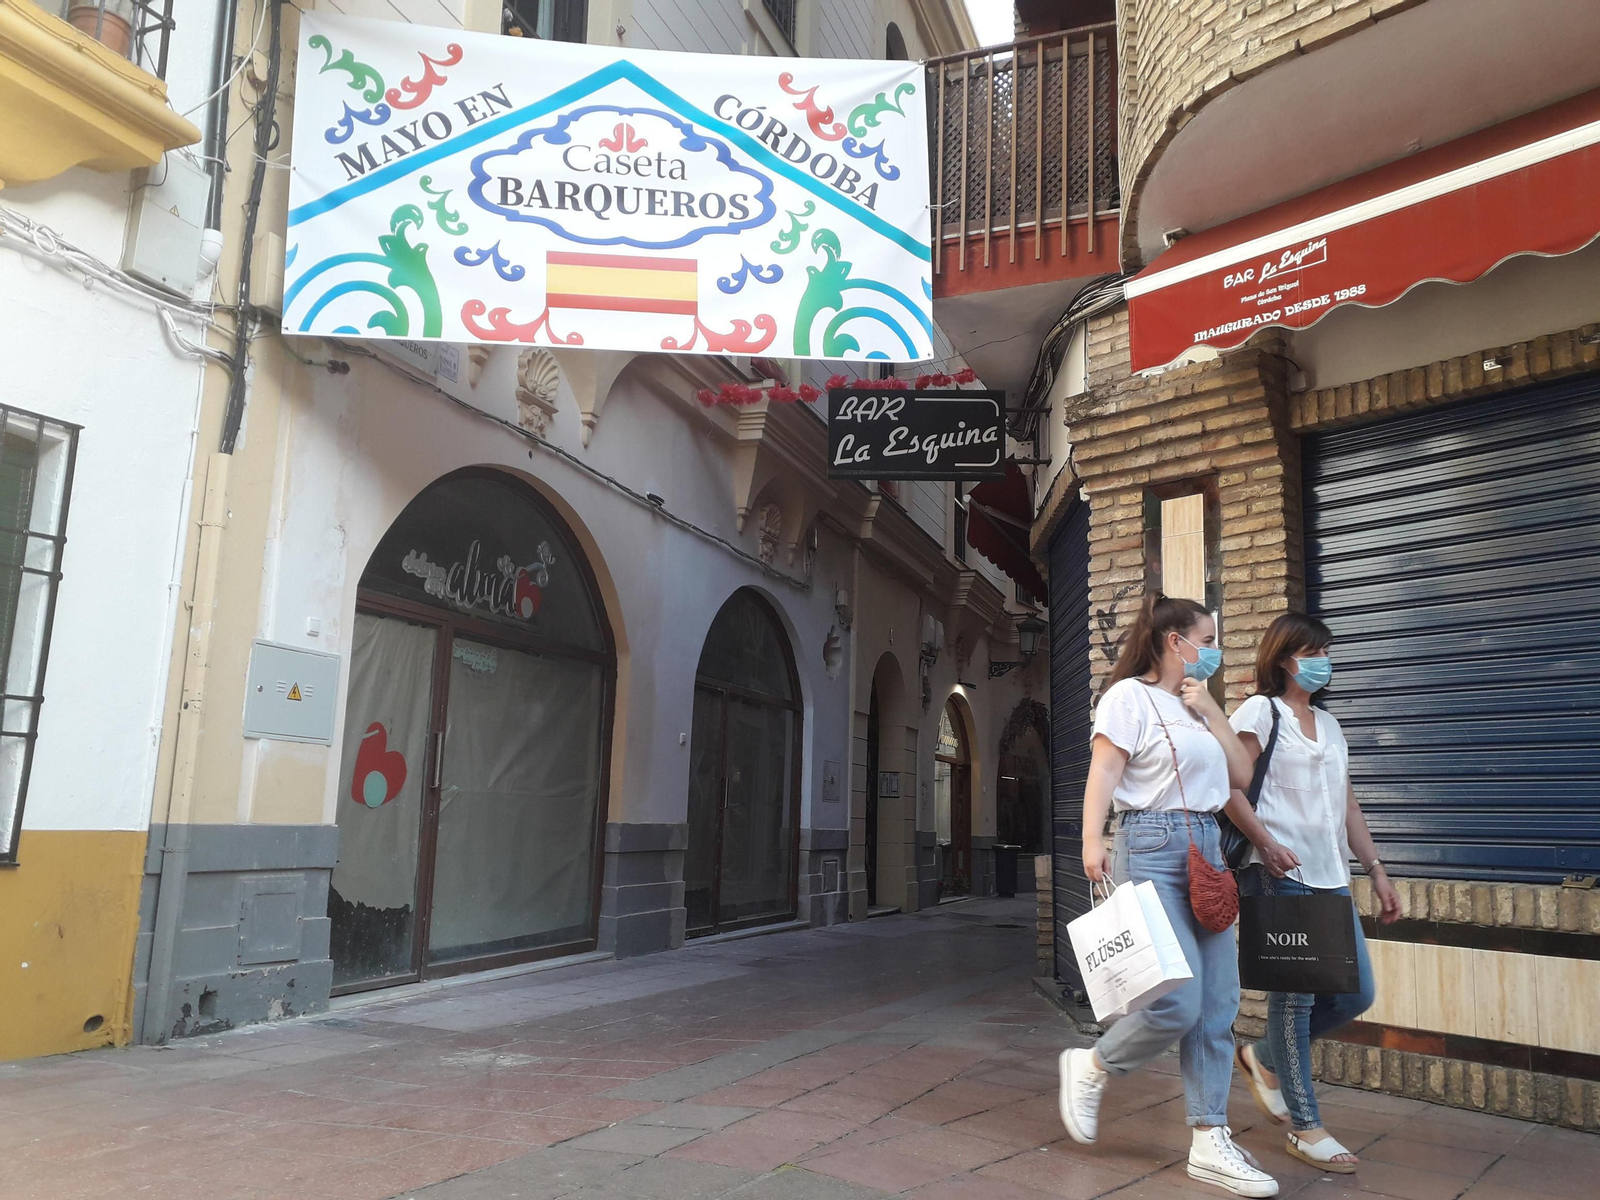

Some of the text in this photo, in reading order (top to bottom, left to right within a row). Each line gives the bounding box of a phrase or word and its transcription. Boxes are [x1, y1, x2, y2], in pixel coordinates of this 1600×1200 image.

[333, 82, 513, 182] MAYO EN
[713, 93, 880, 211] CÓRDOBA
[562, 144, 688, 181] Caseta
[496, 176, 750, 221] BARQUEROS
[1223, 238, 1327, 289] BAR La Esquina
[1193, 283, 1367, 343] INAUGURADO DESDE 1988
[835, 396, 906, 423] BAR
[833, 420, 998, 466] La Esquina
[1085, 929, 1135, 973] FLÜSSE
[1266, 932, 1309, 947] NOIR
